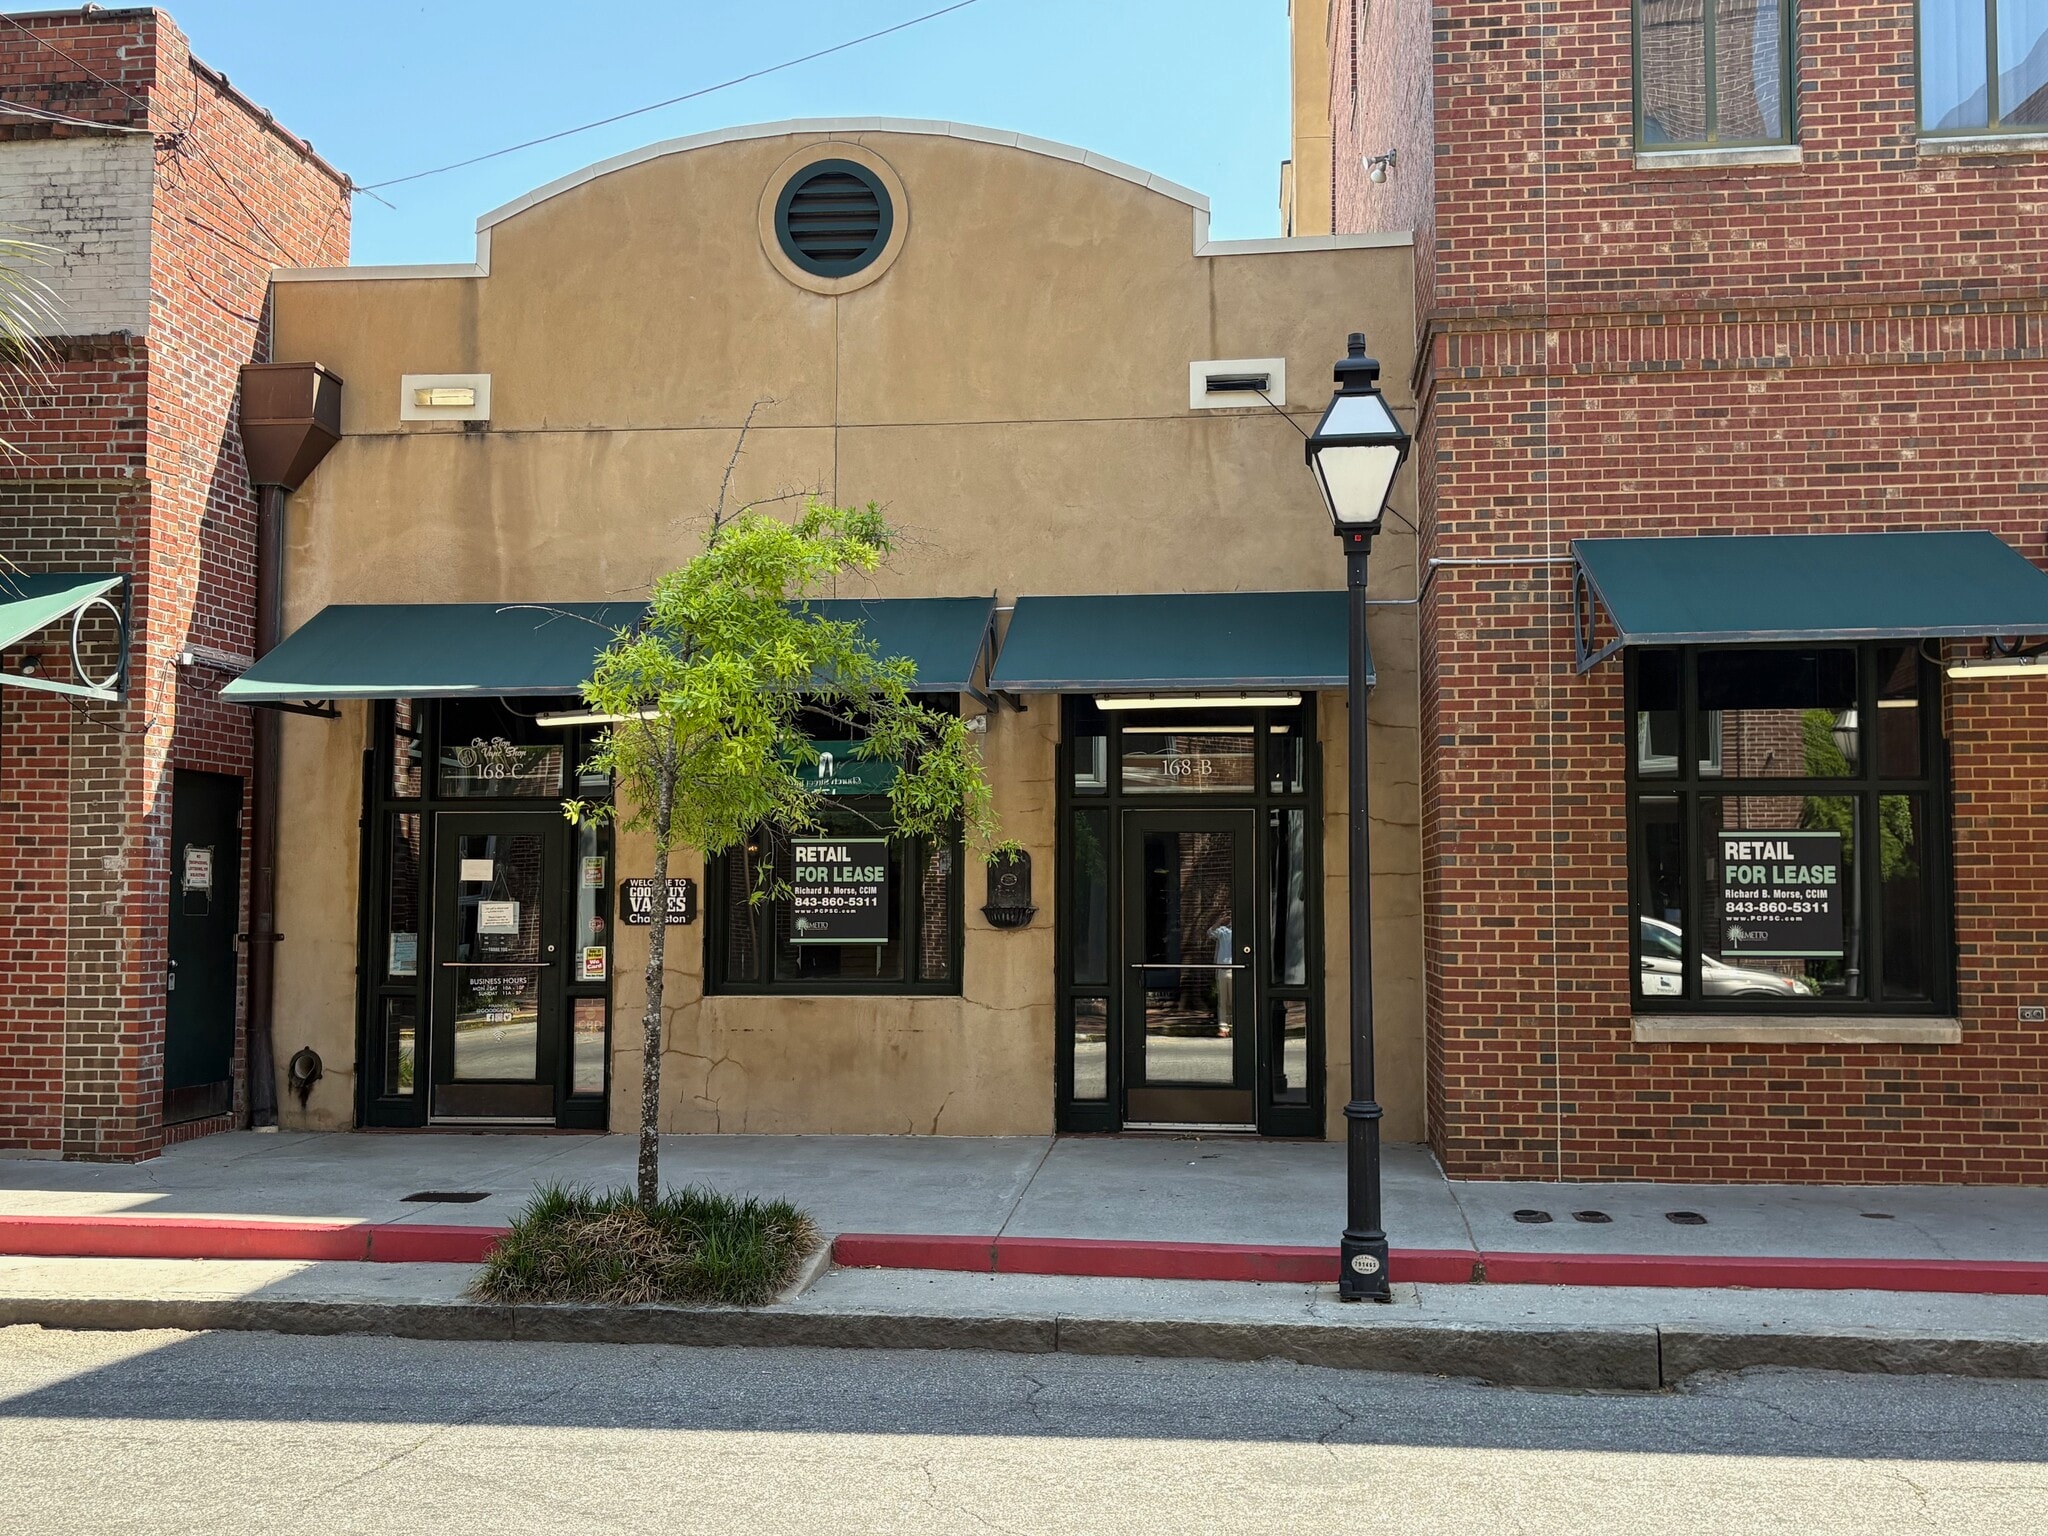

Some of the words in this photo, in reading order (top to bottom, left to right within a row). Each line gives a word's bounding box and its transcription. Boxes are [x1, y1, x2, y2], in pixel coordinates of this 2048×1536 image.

[476, 763, 524, 779] 168-C
[1162, 759, 1212, 775] 168-B
[795, 846, 851, 862] RETAIL
[1725, 841, 1794, 860] RETAIL
[795, 866, 828, 882] FOR
[833, 866, 884, 882] LEASE
[1725, 865, 1766, 884] FOR
[1772, 865, 1837, 884] LEASE
[674, 879, 686, 887] TO
[629, 887, 654, 897] GOO
[794, 886, 822, 895] Richard
[824, 886, 831, 894] B.
[833, 886, 857, 896] Morse,
[859, 886, 877, 894] CCIM
[1725, 889, 1759, 898] Richard
[1762, 889, 1770, 898] B.
[1773, 889, 1803, 900] Morse,
[1805, 889, 1828, 898] CCIM
[629, 897, 686, 912] VAES
[794, 897, 877, 906] 843-860-5311
[1725, 902, 1829, 913] 843-860-5311
[629, 914, 686, 923] Chaston
[470, 977, 501, 985] BUSINESS
[502, 976, 527, 984] HOURS
